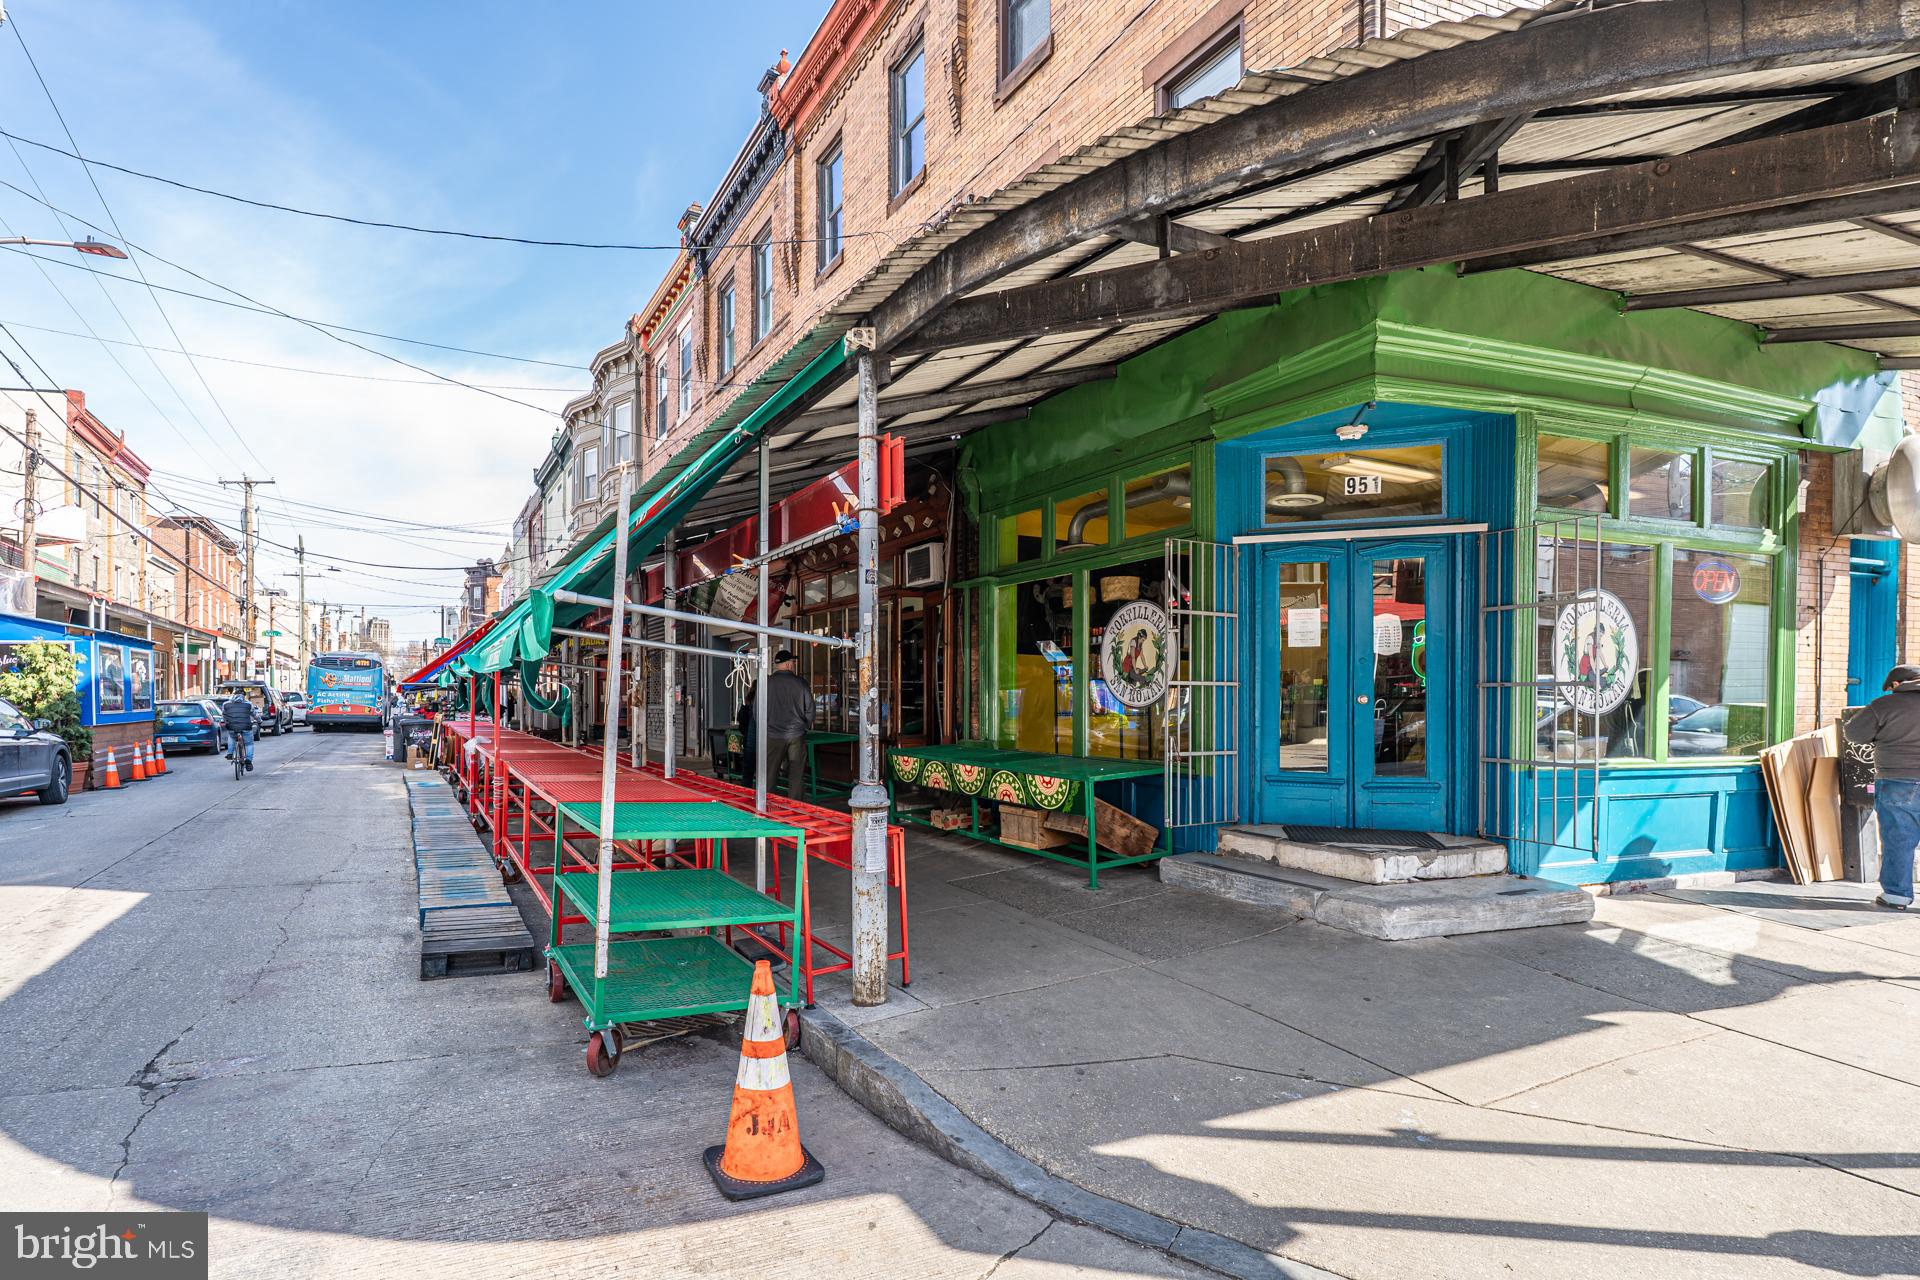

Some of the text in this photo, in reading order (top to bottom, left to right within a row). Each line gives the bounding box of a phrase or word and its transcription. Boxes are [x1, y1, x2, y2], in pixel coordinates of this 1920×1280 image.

[1346, 476, 1379, 495] 951
[1693, 570, 1736, 592] OPEN
[1110, 675, 1128, 698] SAN
